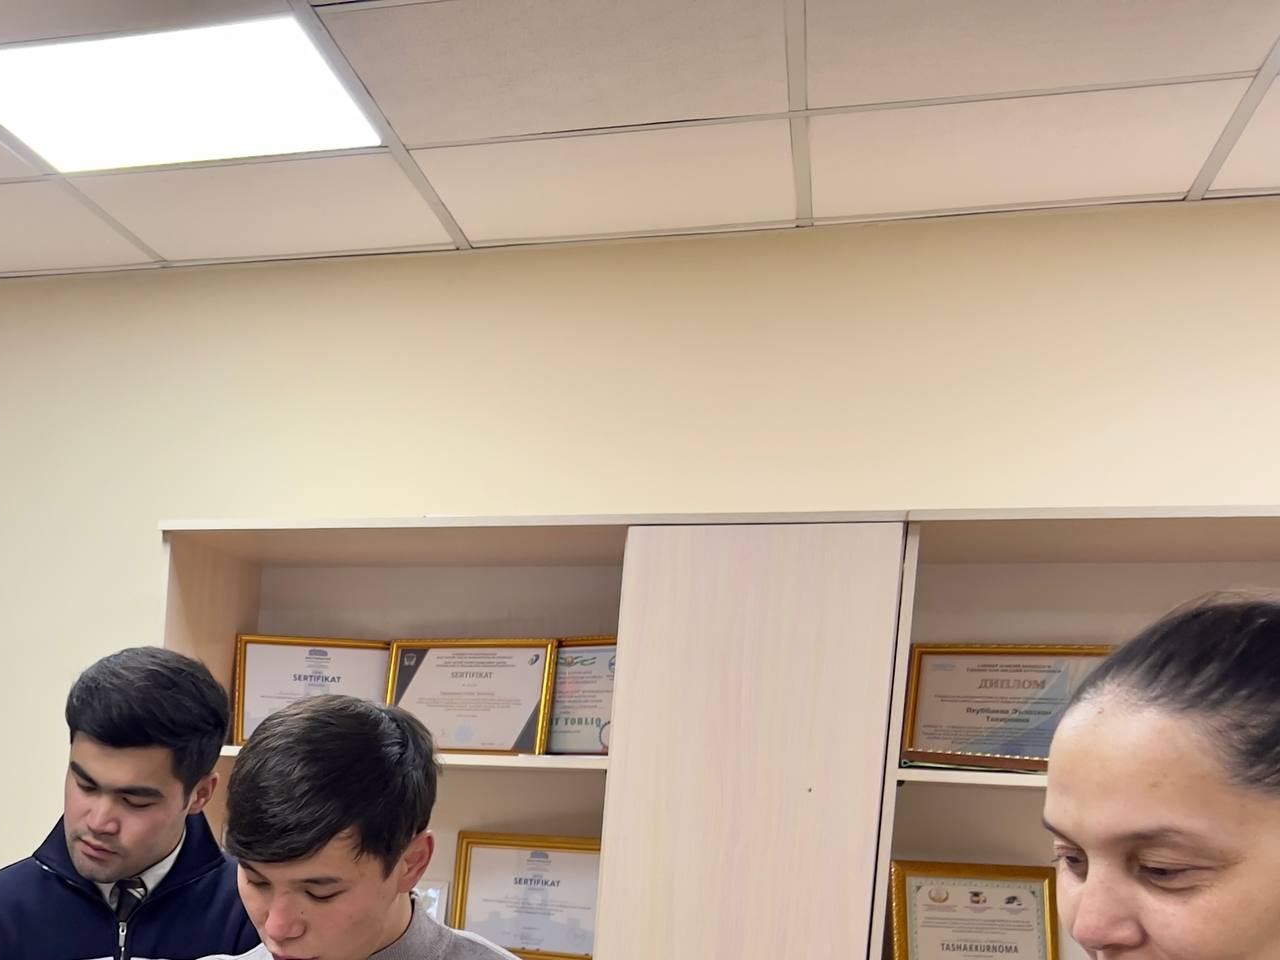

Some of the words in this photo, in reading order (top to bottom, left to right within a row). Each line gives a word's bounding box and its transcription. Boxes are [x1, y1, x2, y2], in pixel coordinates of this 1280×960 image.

[292, 673, 342, 684] SERTIFIKAT
[450, 671, 493, 679] SERTIFIKAT
[977, 678, 1046, 690] ДИПЛОМ
[513, 876, 561, 888] SERTIFIKAT
[940, 942, 1019, 954] TASHAKKURNOMA
